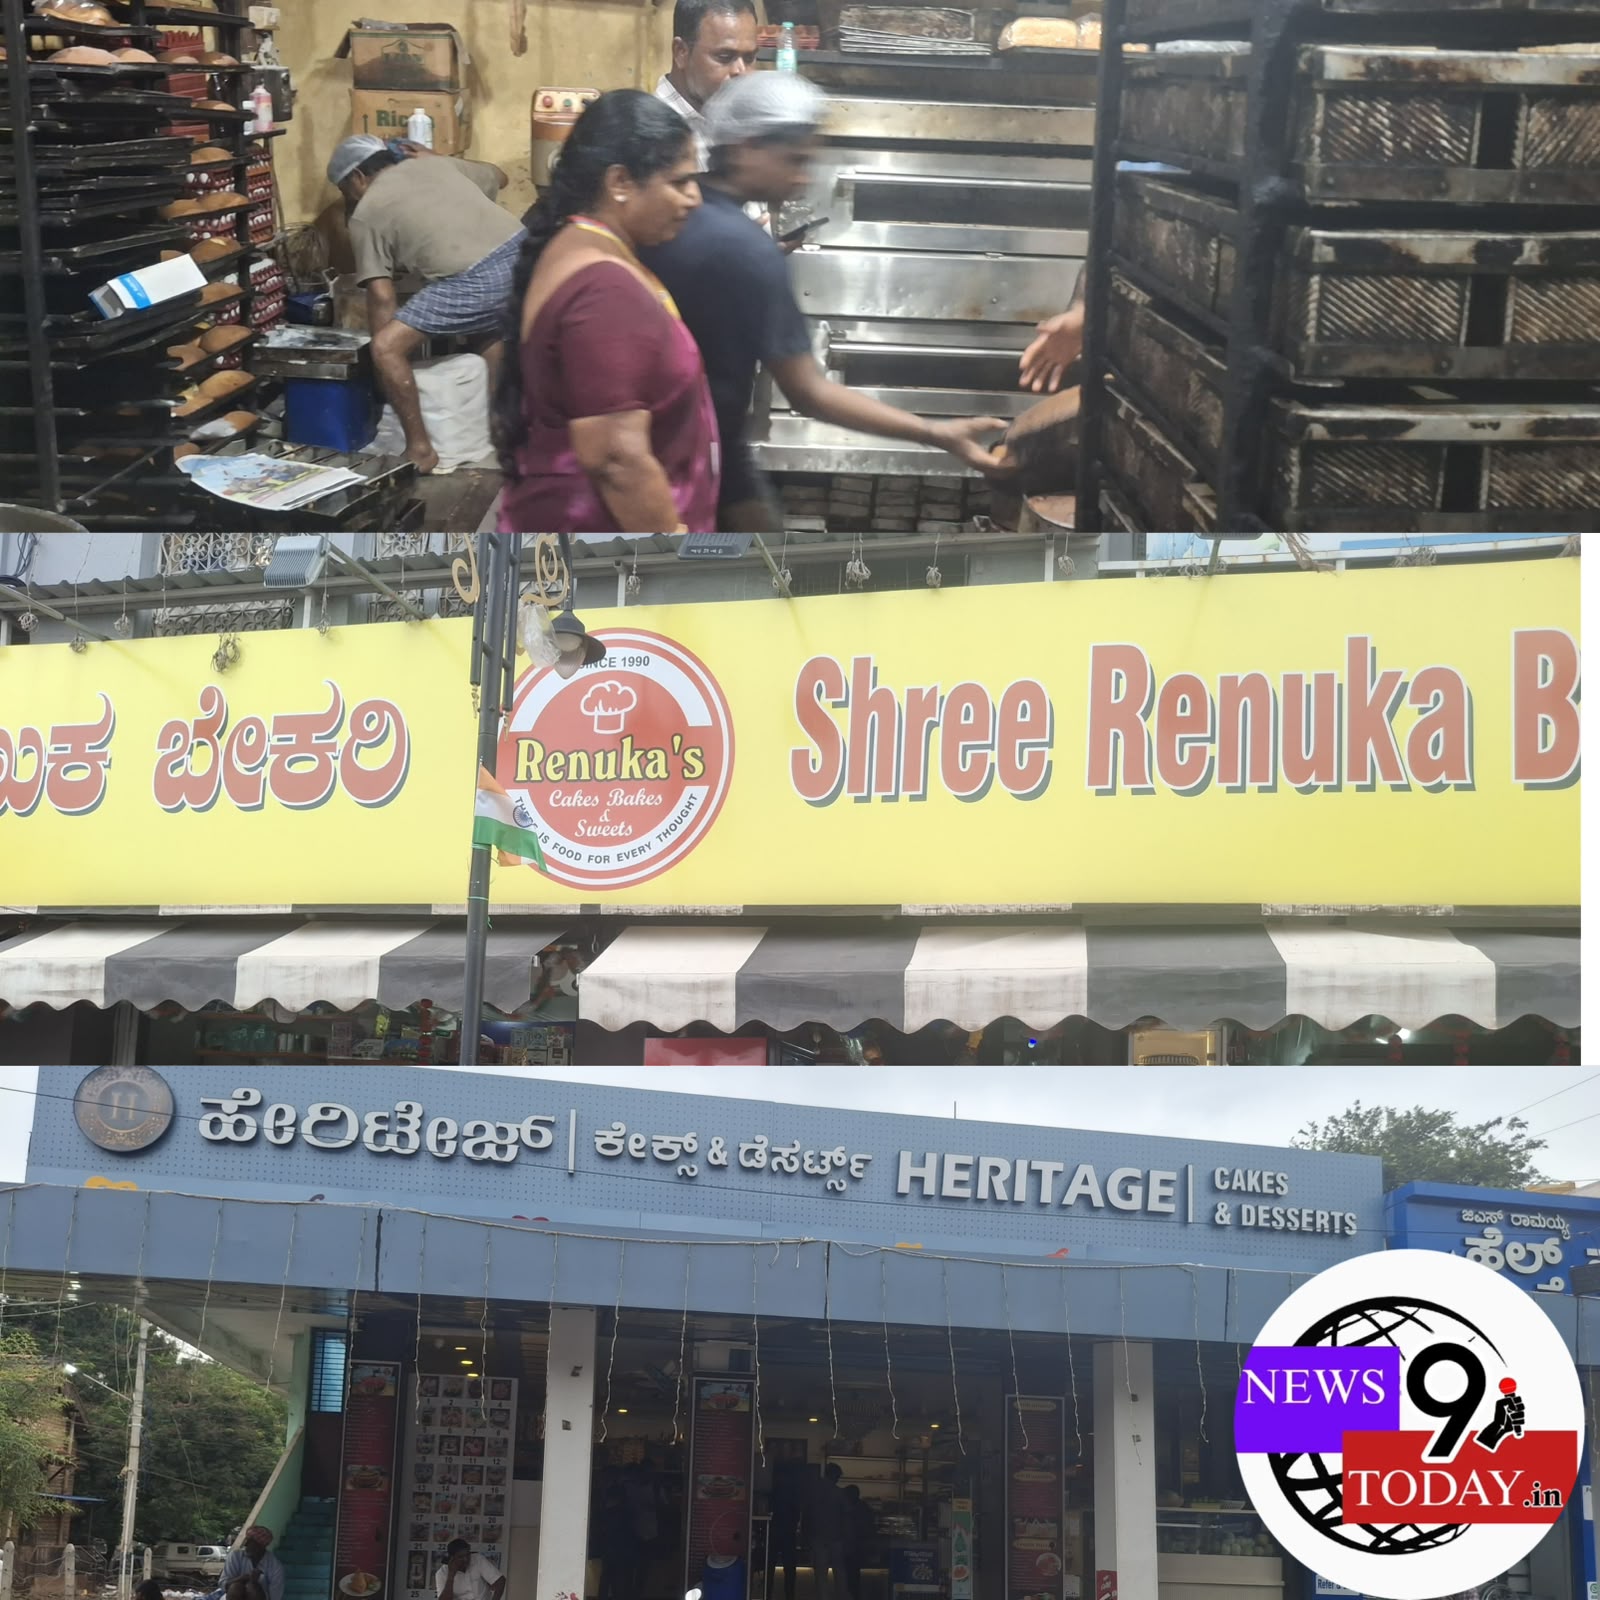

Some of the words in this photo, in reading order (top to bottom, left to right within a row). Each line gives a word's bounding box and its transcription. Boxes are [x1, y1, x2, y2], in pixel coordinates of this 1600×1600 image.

[621, 655, 650, 667] 1990
[790, 655, 1055, 808] Shree
[1085, 634, 1476, 798] Renuka
[153, 680, 410, 814] ಬೇಕರಿ
[514, 733, 706, 783] Renuka's
[549, 788, 601, 807] Cakes
[606, 787, 663, 807] Bakes
[599, 808, 611, 823] &
[538, 832, 550, 844] IS
[551, 842, 583, 862] FOOD
[587, 855, 611, 864] FOR
[617, 841, 653, 863] EVERY
[656, 793, 698, 844] THOUGHT
[574, 819, 633, 838] Sweets
[198, 1087, 556, 1164] ಹೇರಿಟೇಜ್
[594, 1121, 699, 1178] ಕೇಕ್ಸ್
[707, 1136, 729, 1167] &
[897, 1150, 1178, 1214] HERITAGE
[1214, 1166, 1289, 1196] CAKES
[1214, 1202, 1231, 1226] &
[1241, 1204, 1358, 1237] DESSERTS
